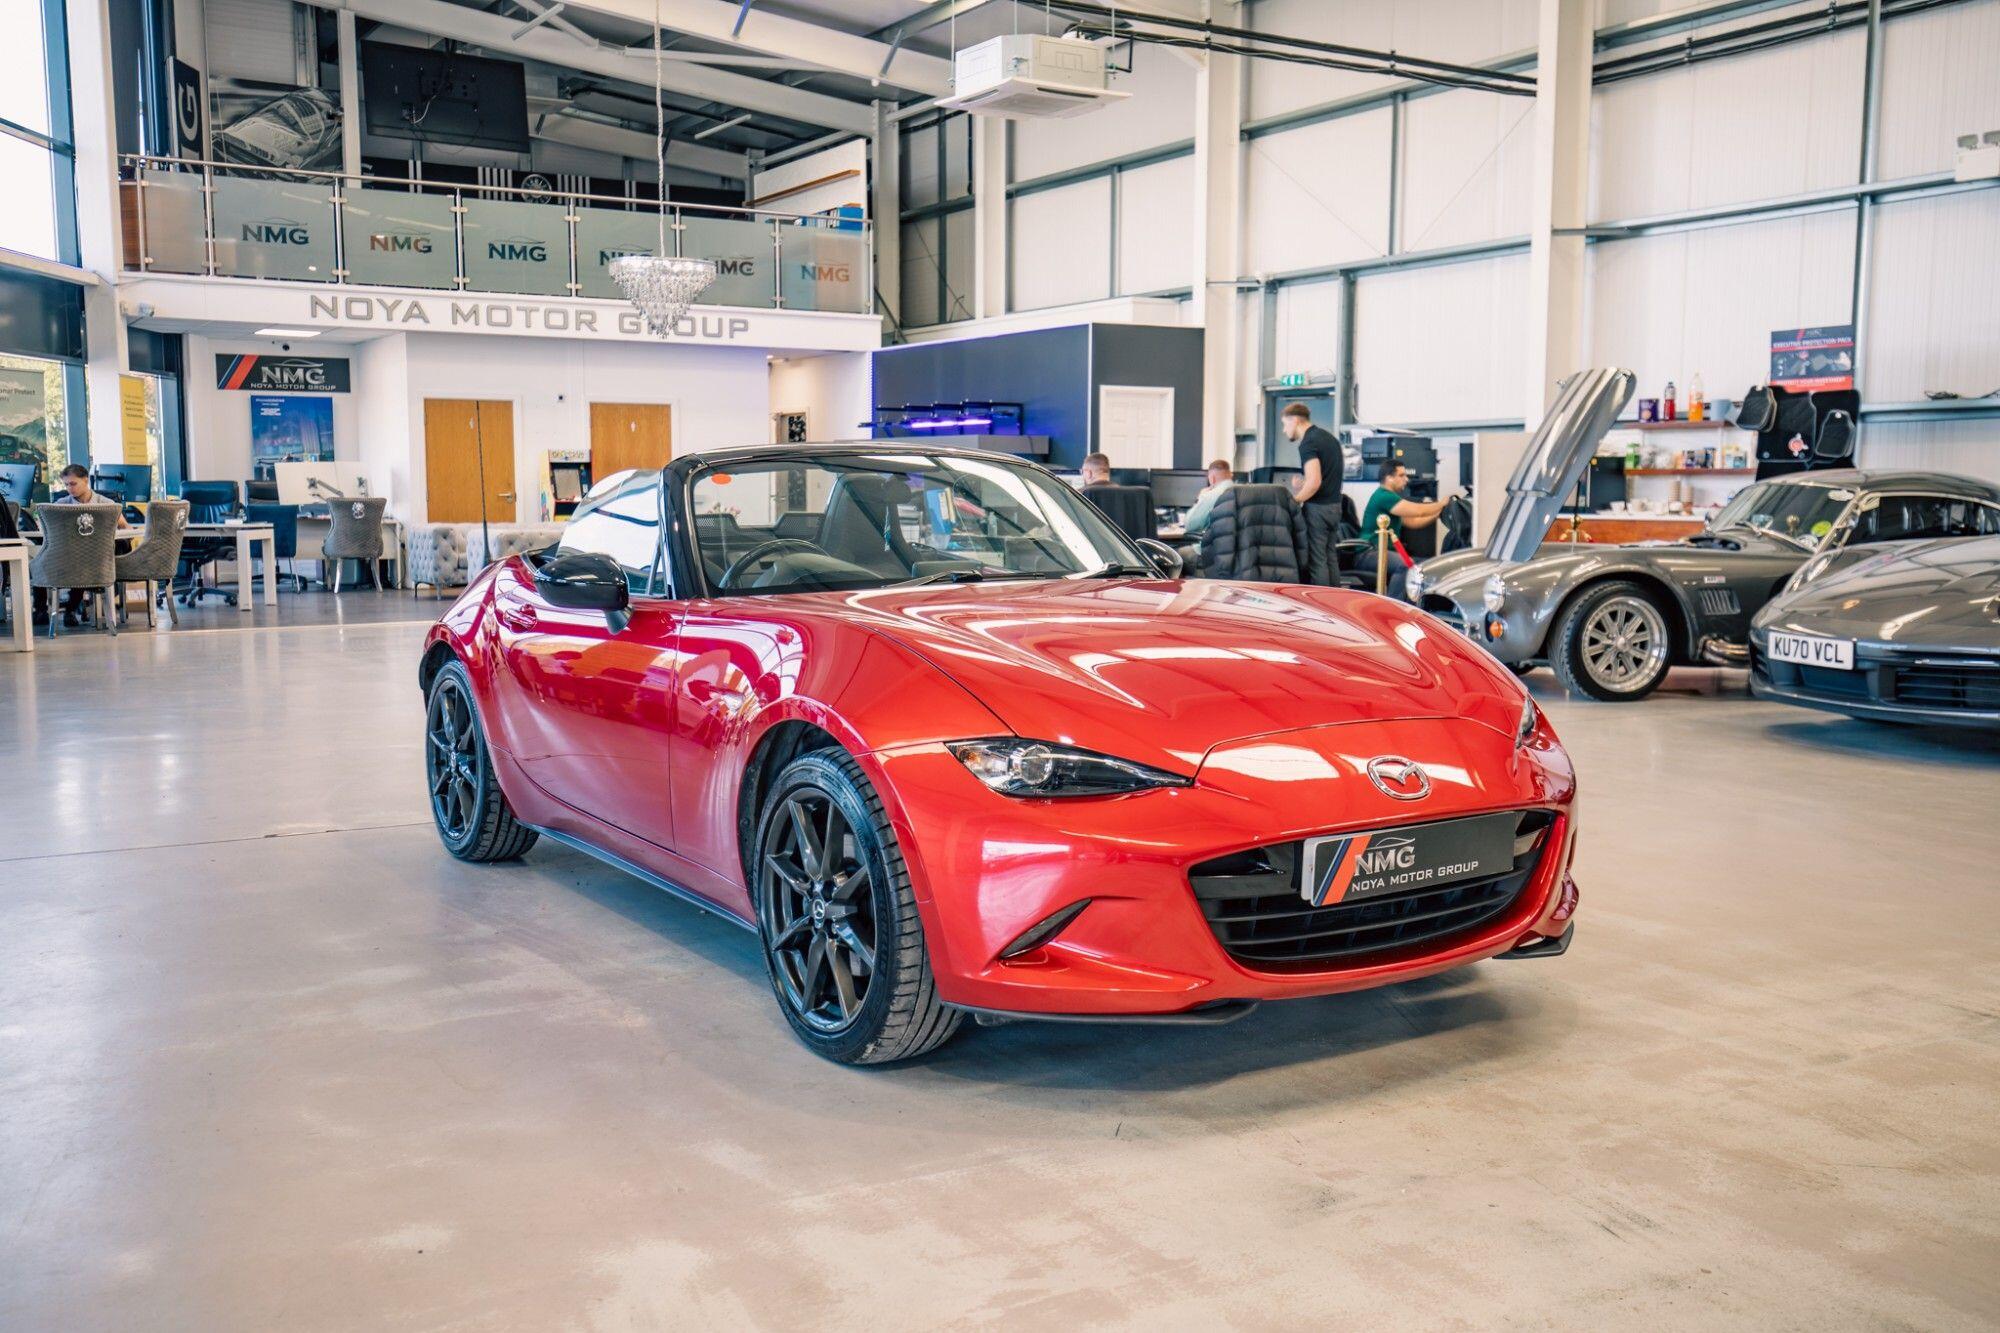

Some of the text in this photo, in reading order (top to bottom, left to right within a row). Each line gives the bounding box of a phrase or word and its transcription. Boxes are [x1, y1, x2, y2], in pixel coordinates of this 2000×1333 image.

[242, 224, 309, 245] NMG
[369, 234, 432, 254] NMG
[488, 243, 547, 262] NMG
[801, 264, 849, 282] NMG
[310, 296, 749, 339] NOYA MOTOR GOUP
[261, 366, 325, 384] NMG
[1774, 636, 1844, 663] KU70 VCL
[1354, 846, 1415, 876] NMG
[1352, 861, 1479, 892] NOYA MOTOR GROUP
